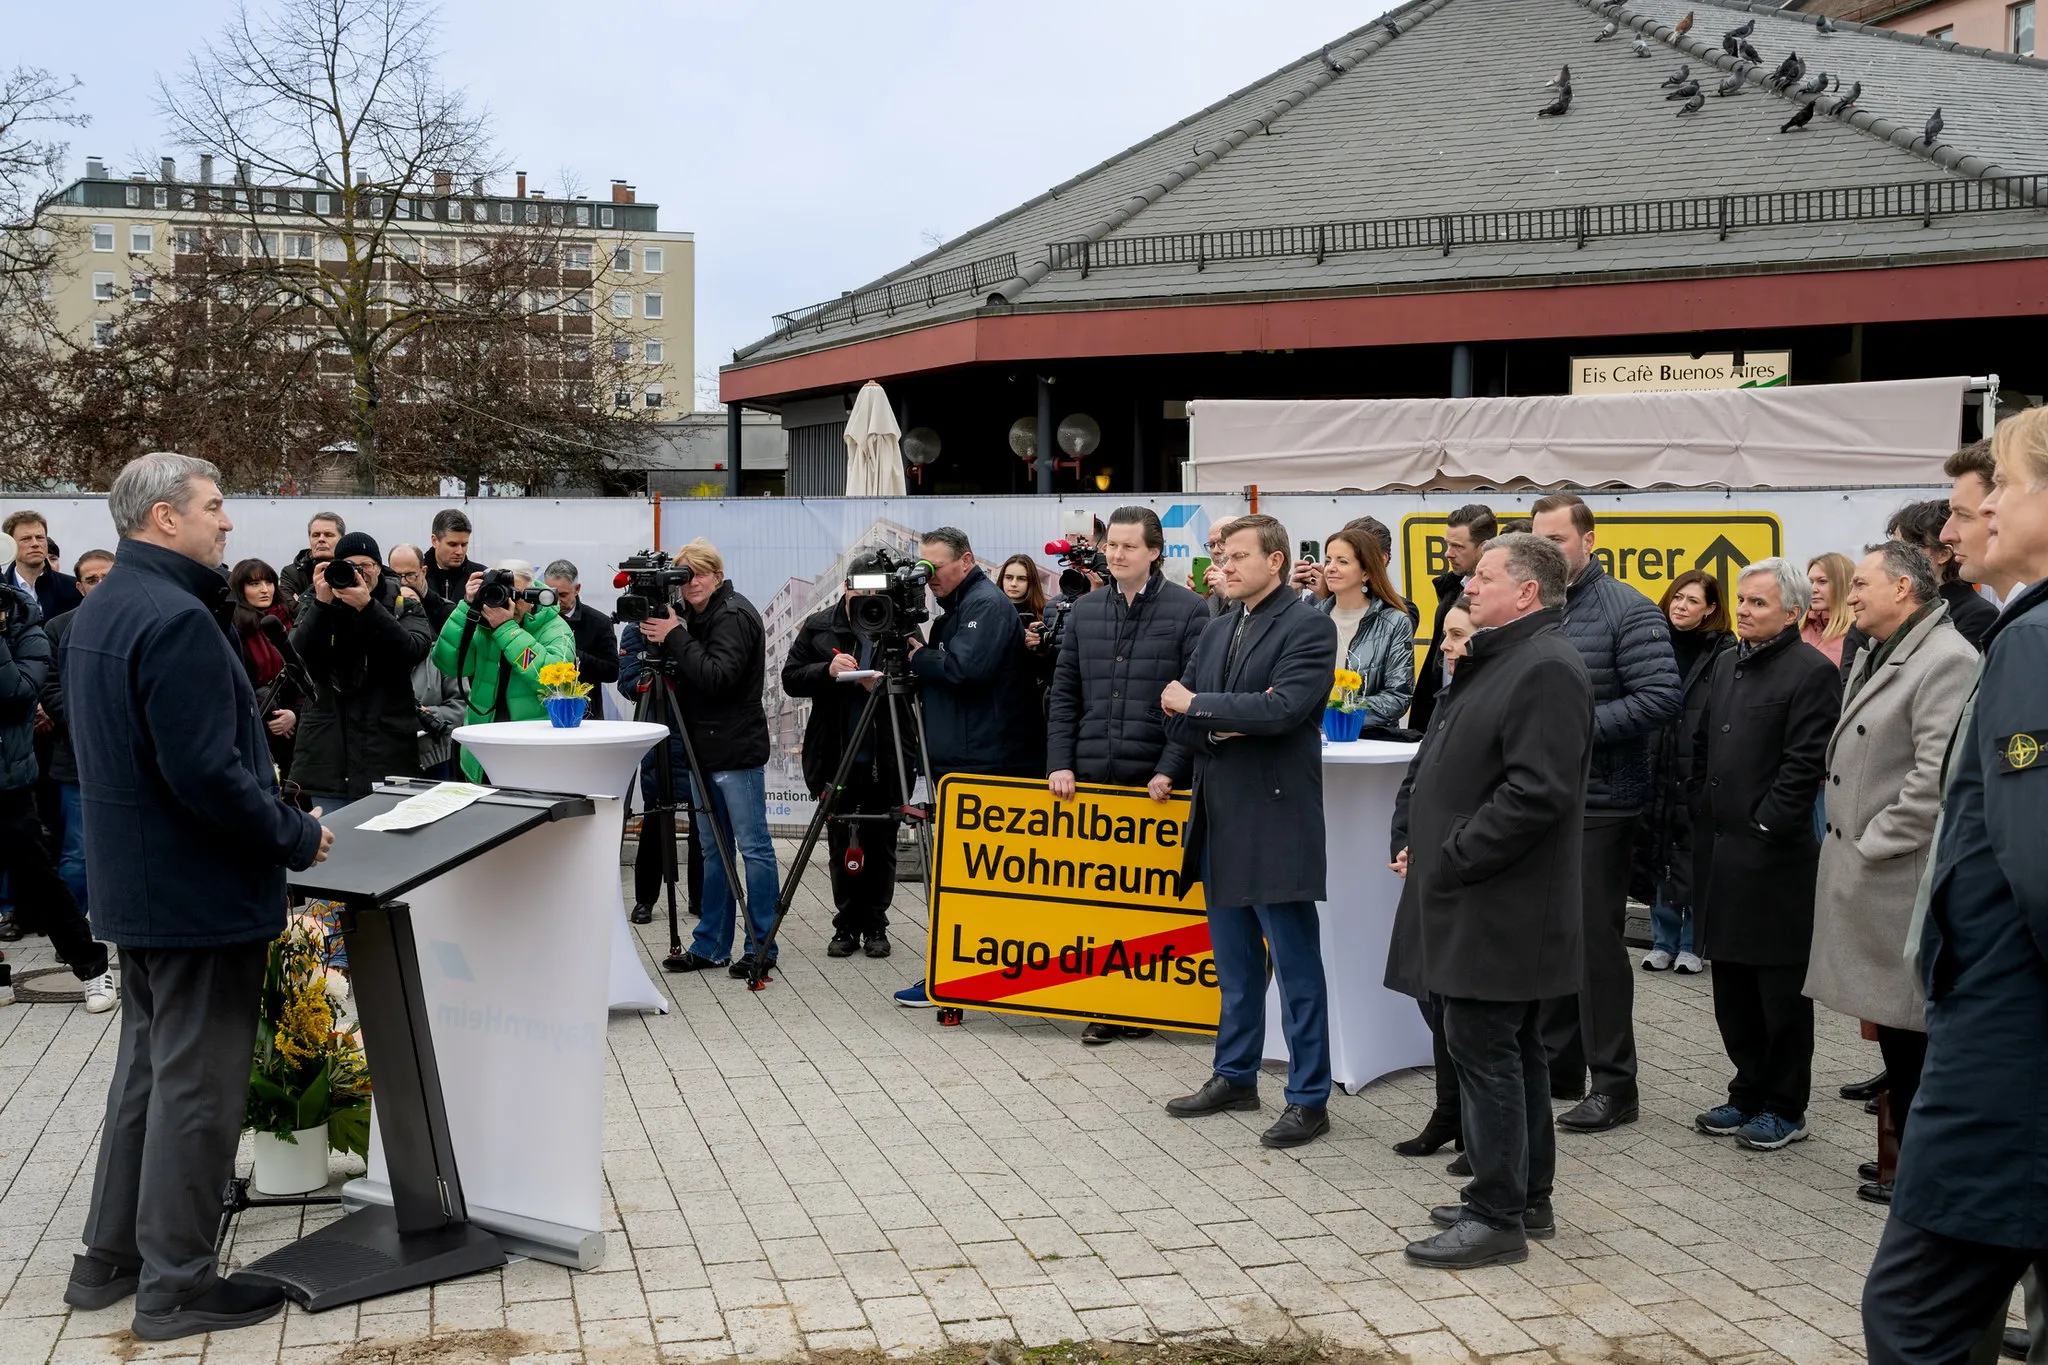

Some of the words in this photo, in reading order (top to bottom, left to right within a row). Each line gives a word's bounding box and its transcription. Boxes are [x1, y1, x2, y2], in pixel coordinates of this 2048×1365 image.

[1583, 367, 1606, 383] Eis
[1613, 366, 1653, 381] Cafè
[1660, 365, 1724, 381] Buenos
[1729, 362, 1775, 378] Aires
[963, 842, 1180, 897] Wohnraum
[952, 924, 1050, 980] Lago
[1059, 935, 1094, 975] di
[1100, 939, 1220, 987] Aufse
